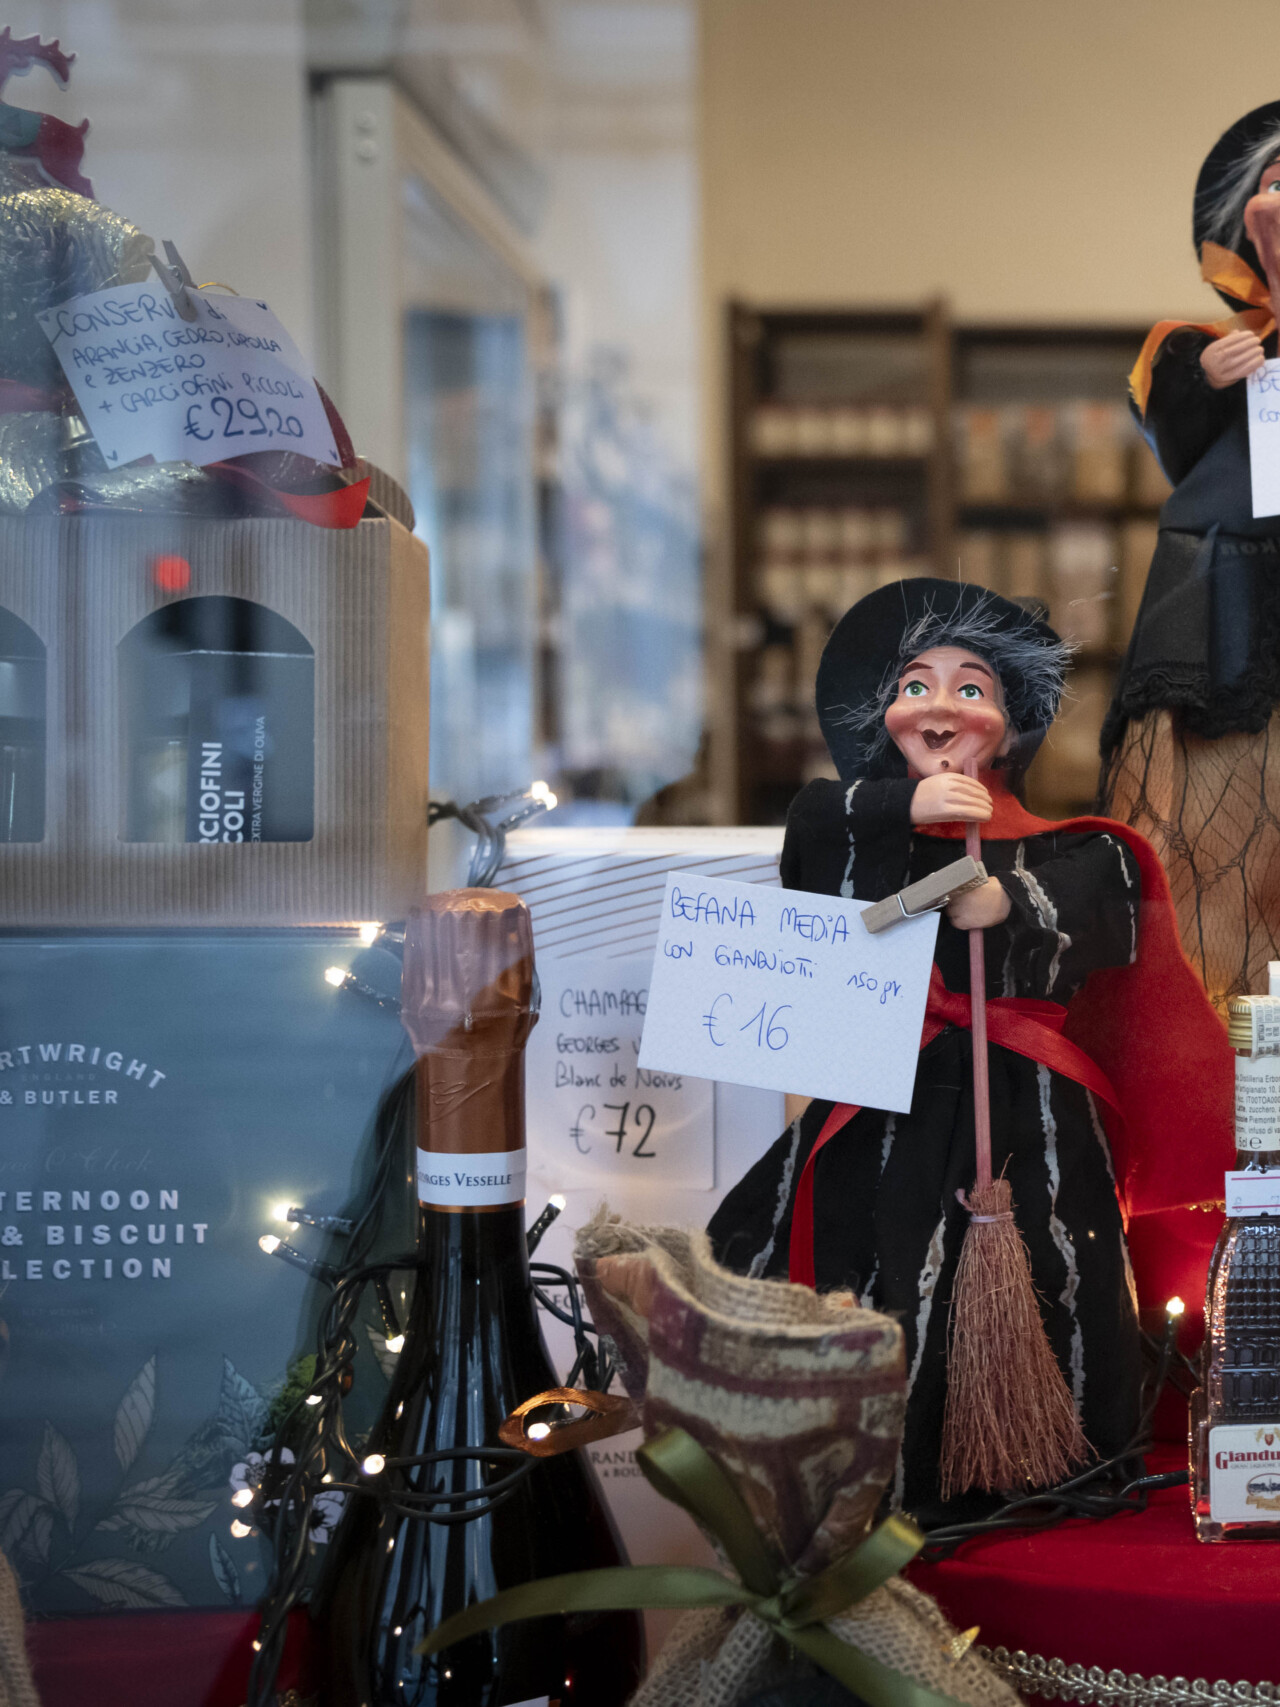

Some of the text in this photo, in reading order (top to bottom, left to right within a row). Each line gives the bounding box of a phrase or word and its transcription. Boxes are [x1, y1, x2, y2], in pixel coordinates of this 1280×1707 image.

[56, 293, 177, 337] CONSERV
[102, 353, 205, 385] ZENZERO
[255, 715, 266, 749] OLIVA
[254, 750, 264, 762] DI
[252, 763, 264, 811] VERGINE
[671, 886, 757, 929] BEFANA
[556, 1032, 621, 1054] GEORGES
[555, 1060, 602, 1088] Blanc
[609, 1063, 627, 1088] de
[24, 1090, 119, 1105] BUTLER
[1, 1223, 208, 1246] & BISCUIT
